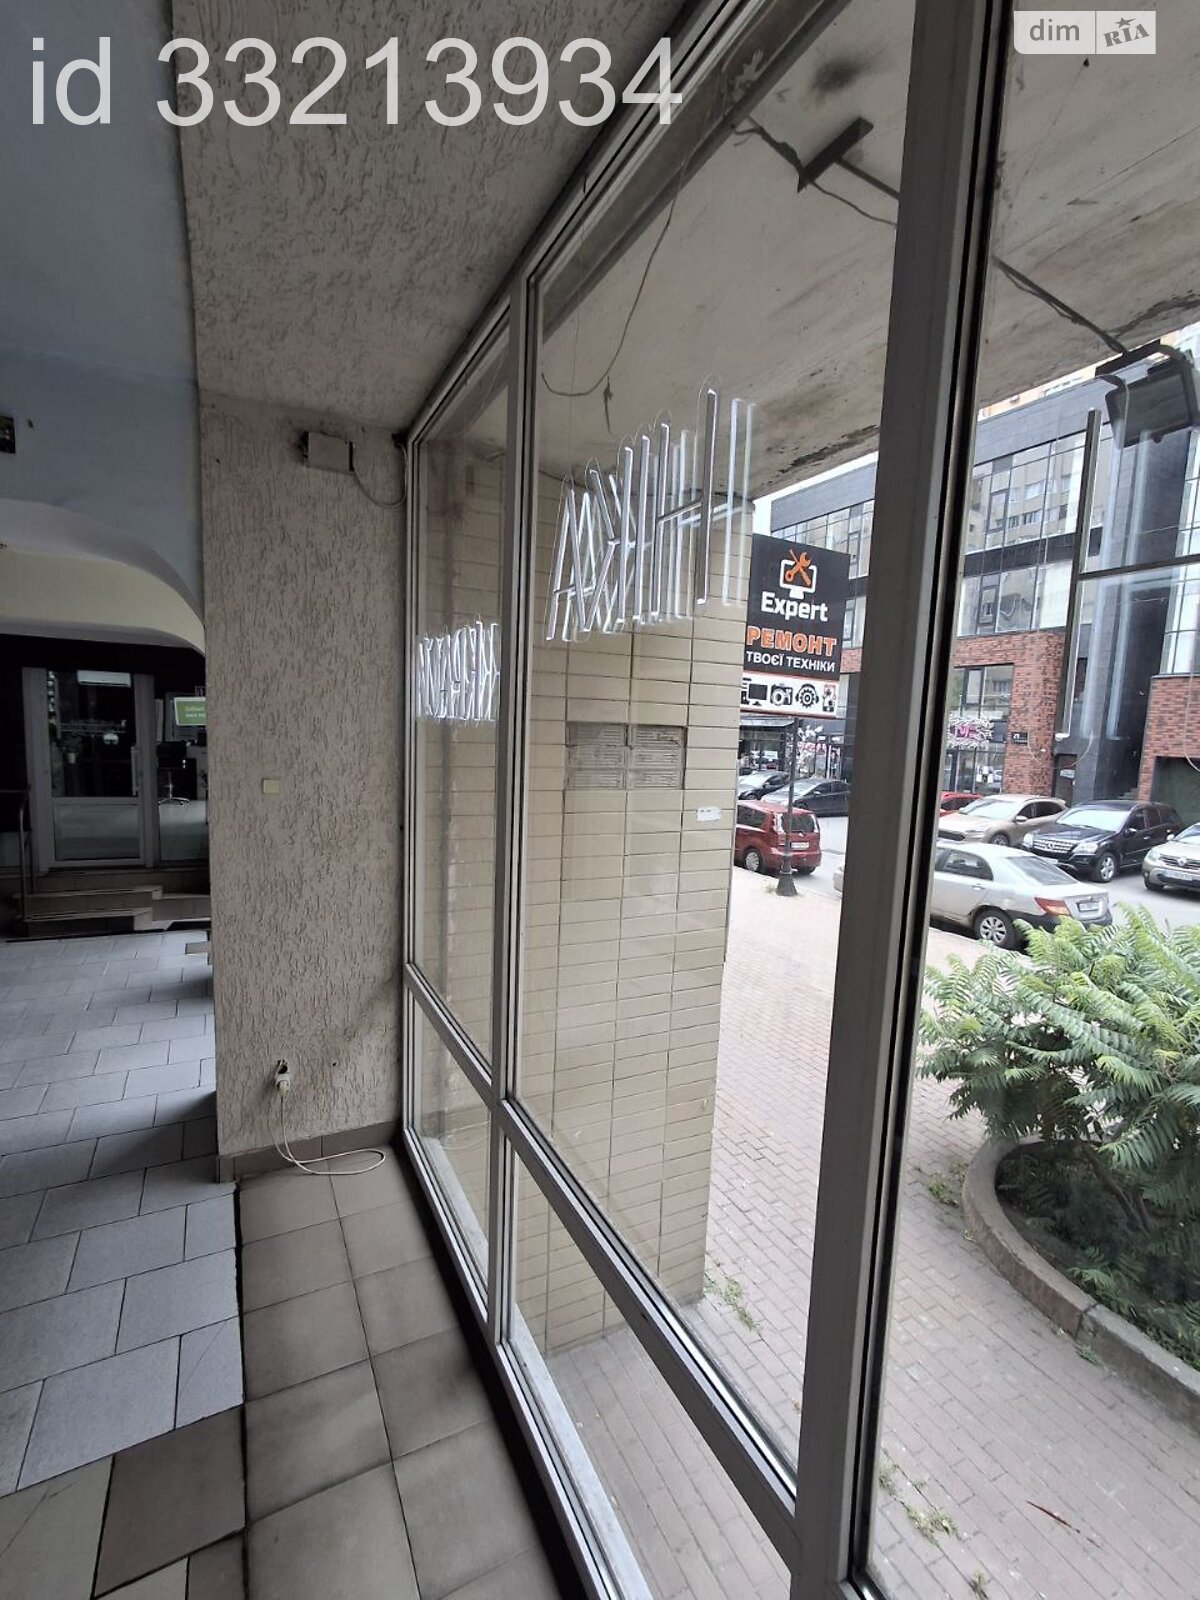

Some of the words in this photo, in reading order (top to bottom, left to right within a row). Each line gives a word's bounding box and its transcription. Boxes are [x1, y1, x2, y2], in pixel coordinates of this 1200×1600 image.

[760, 590, 829, 622] Expert
[746, 625, 837, 657] РЕМОНТ
[746, 650, 785, 667] ТВОЄЇ
[785, 655, 836, 673] ТЕХНІКИ
